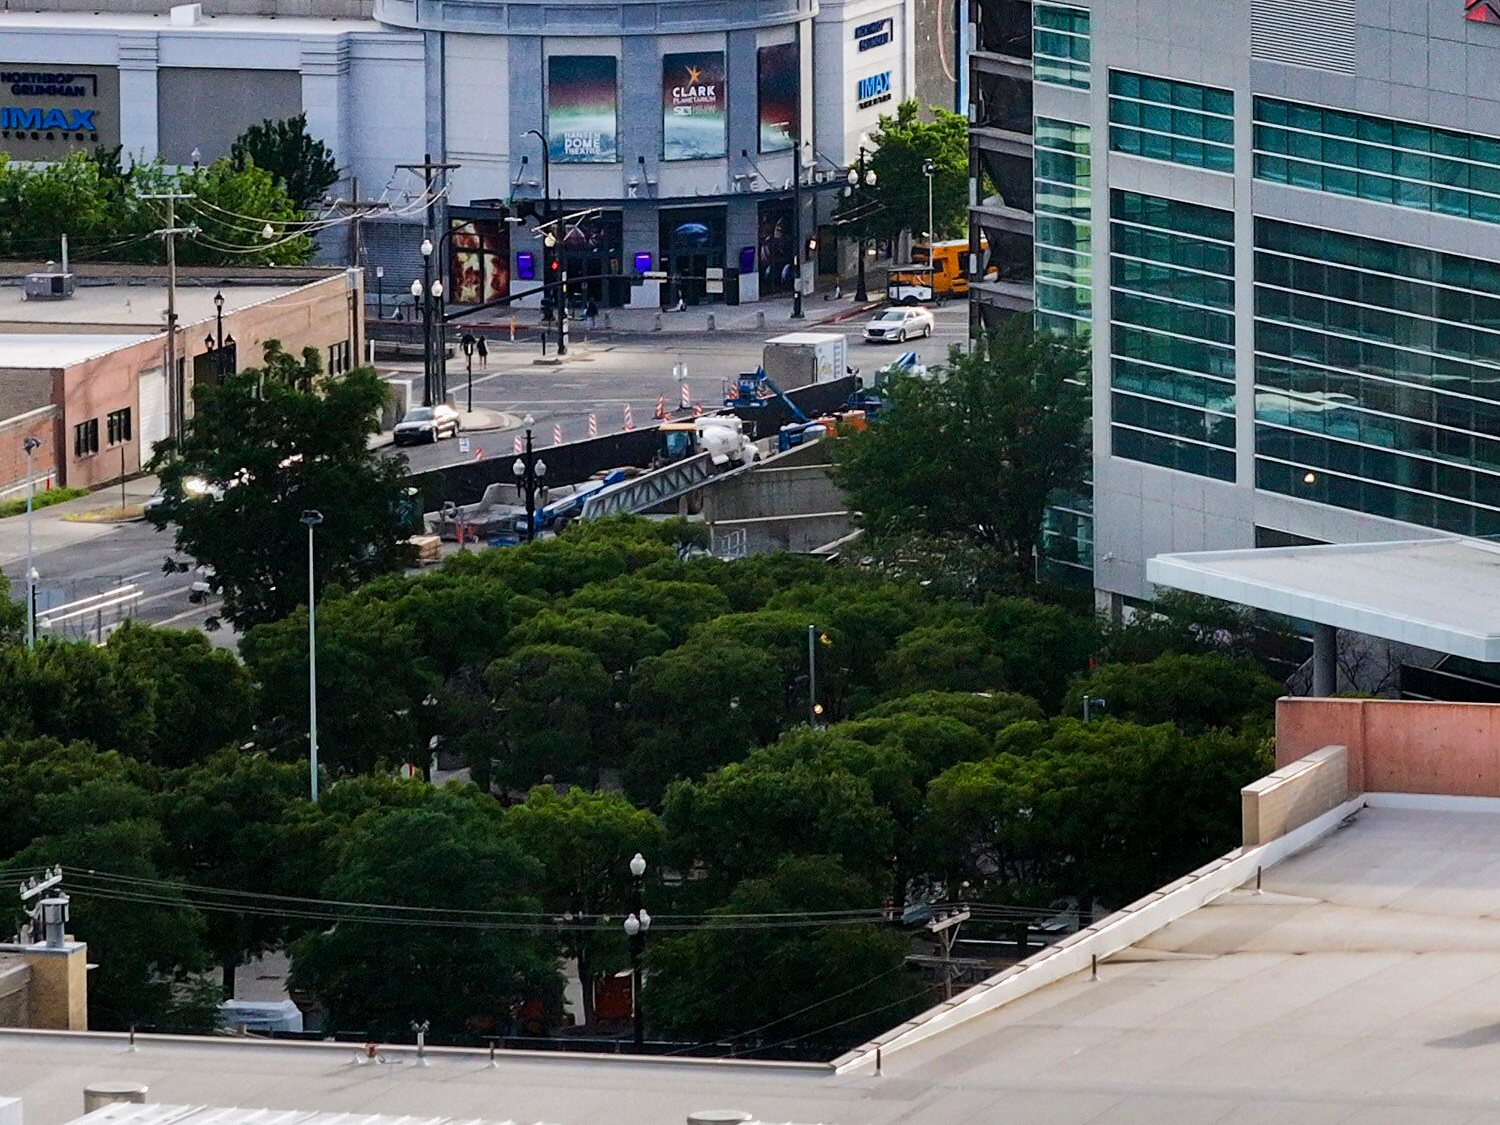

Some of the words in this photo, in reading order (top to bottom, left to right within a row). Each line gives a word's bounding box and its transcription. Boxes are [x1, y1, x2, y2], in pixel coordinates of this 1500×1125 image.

[11, 83, 85, 97] GRUMMAN
[672, 85, 717, 98] CLARK
[858, 70, 892, 101] IMAX
[0, 106, 97, 131] IMAX
[564, 138, 601, 148] DOME
